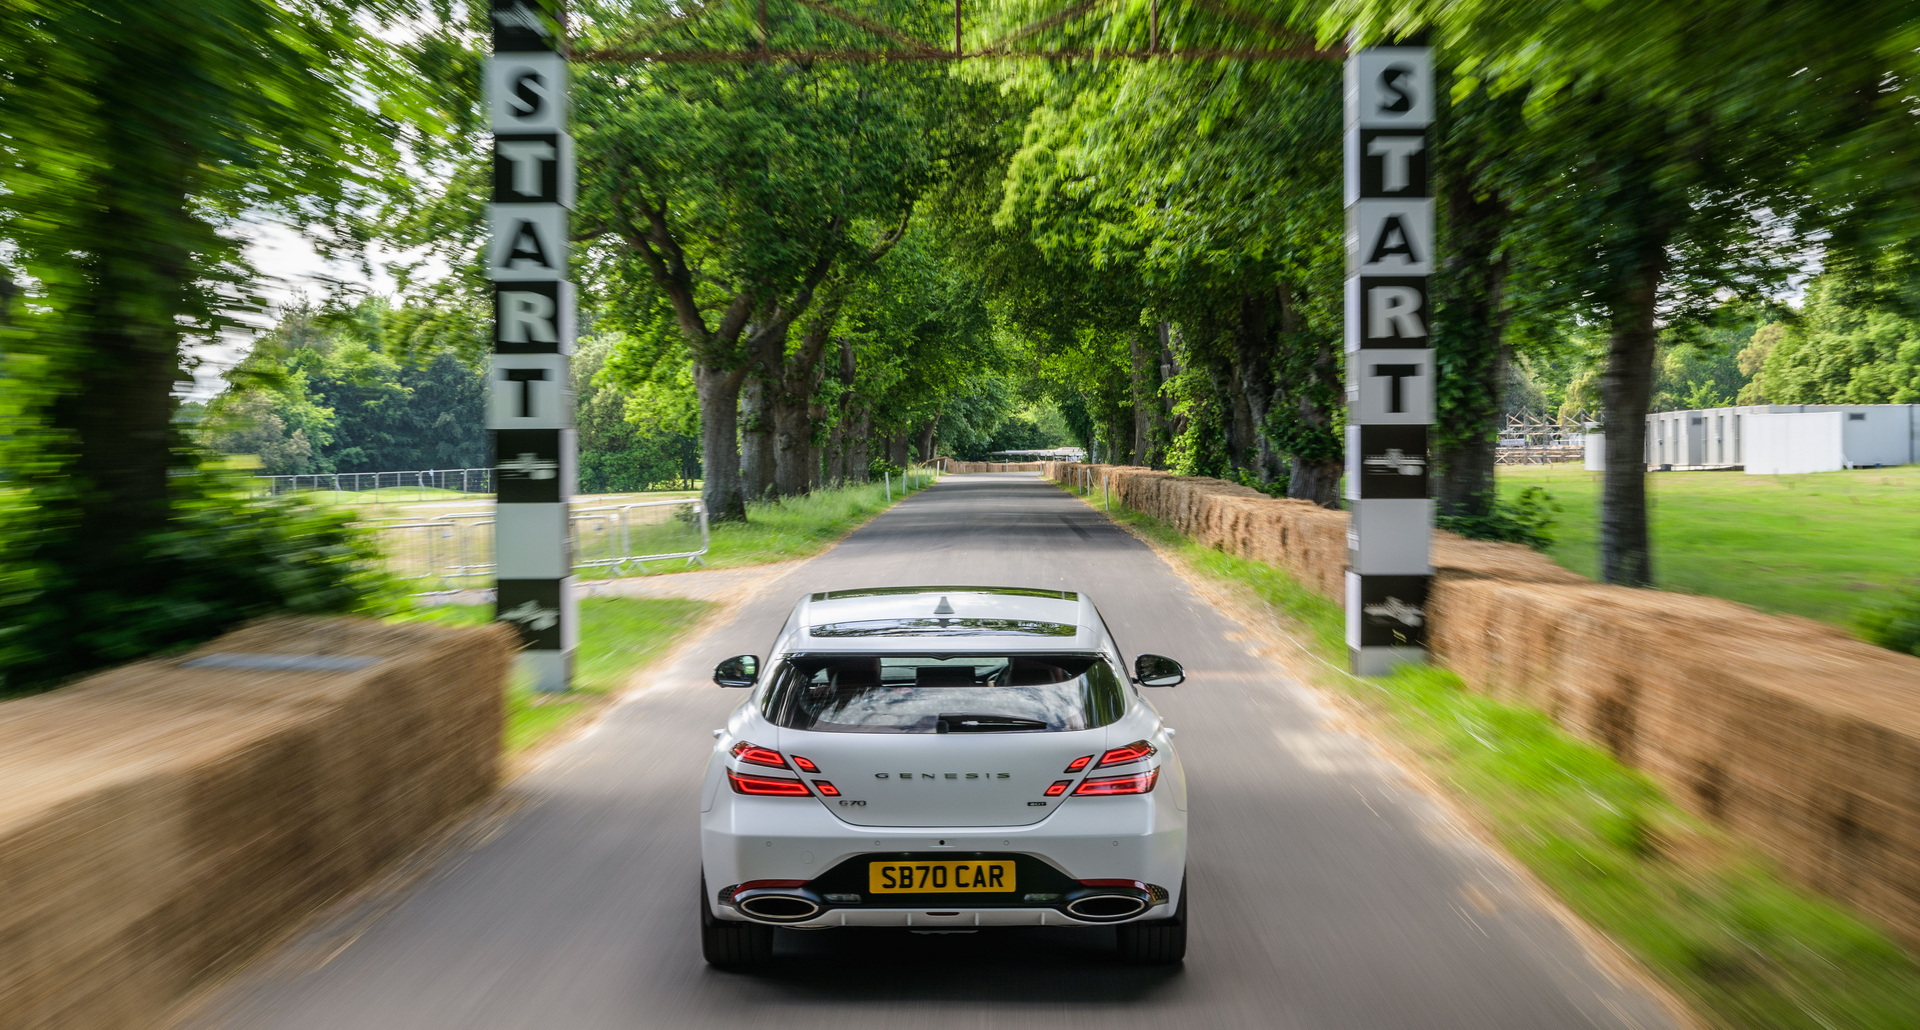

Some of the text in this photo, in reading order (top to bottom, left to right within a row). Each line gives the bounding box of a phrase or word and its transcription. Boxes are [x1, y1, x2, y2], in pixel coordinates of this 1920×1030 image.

[497, 66, 557, 418] START
[1366, 61, 1427, 414] START
[874, 772, 1011, 780] GENESIS
[881, 865, 1004, 889] SB70 CAR
